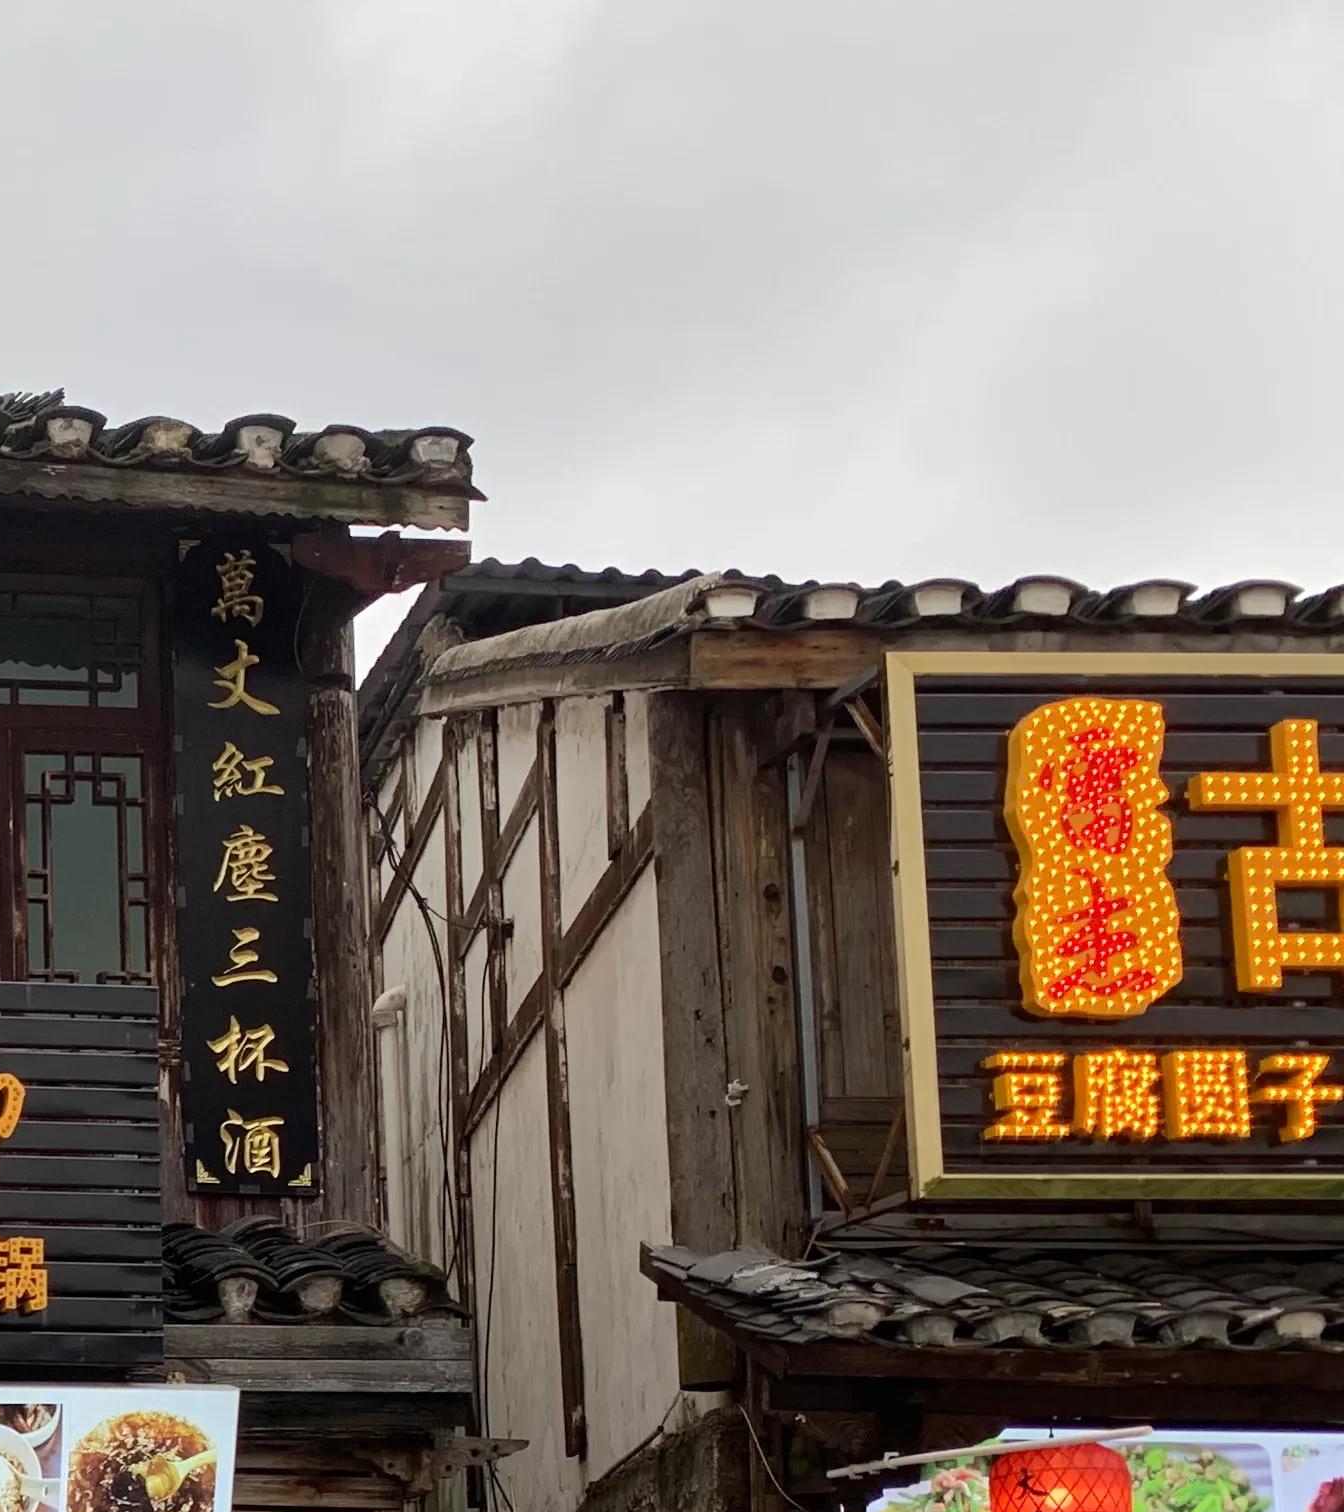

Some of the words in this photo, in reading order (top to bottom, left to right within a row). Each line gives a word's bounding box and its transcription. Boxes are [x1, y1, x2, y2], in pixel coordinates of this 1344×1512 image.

[205, 549, 290, 1179] 萬丈紅塵三杯酒
